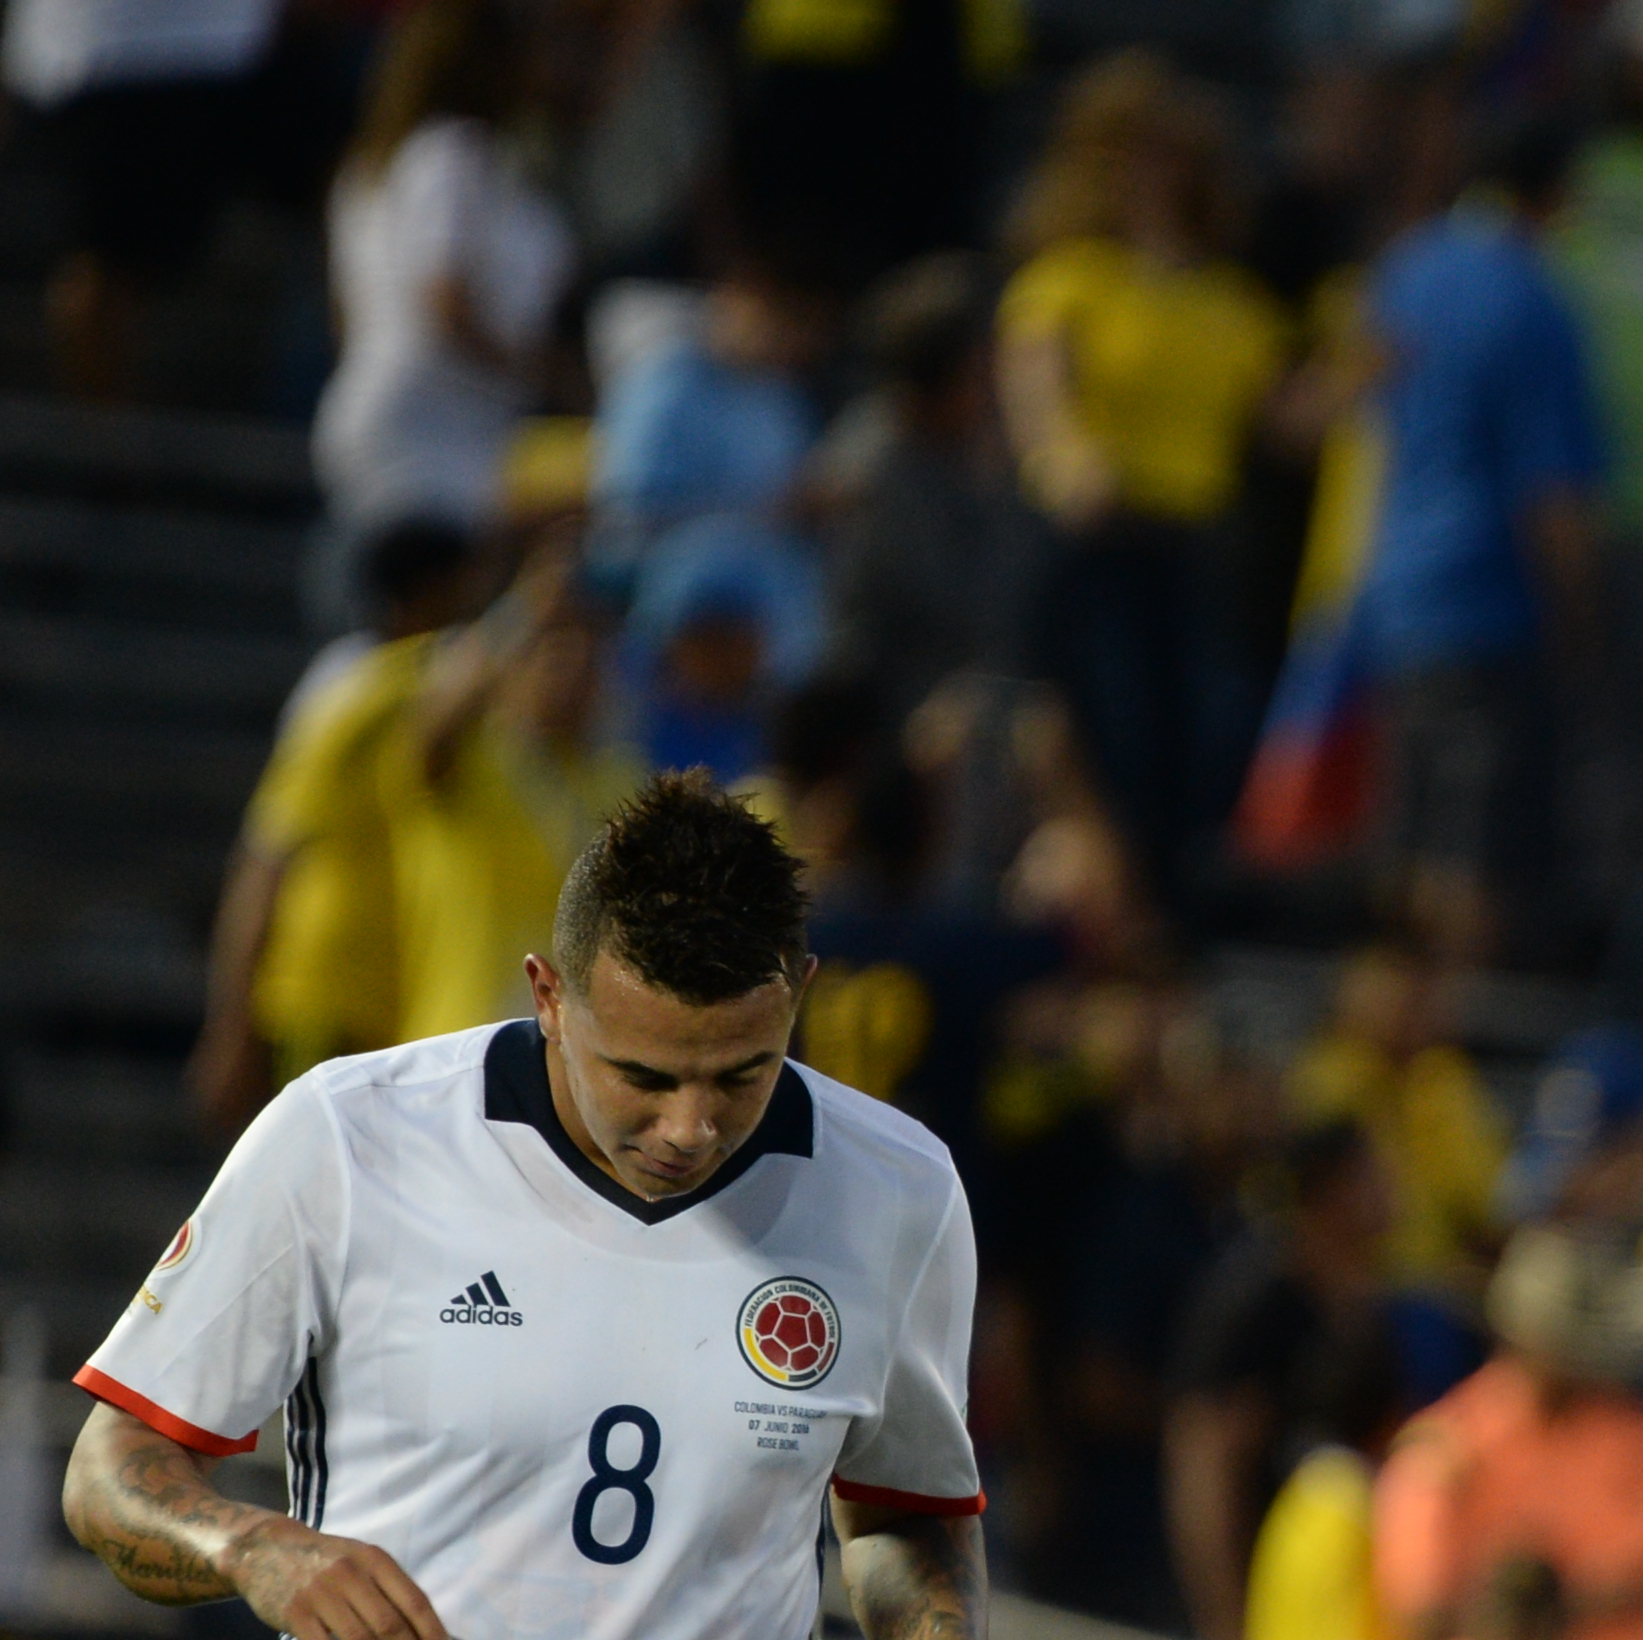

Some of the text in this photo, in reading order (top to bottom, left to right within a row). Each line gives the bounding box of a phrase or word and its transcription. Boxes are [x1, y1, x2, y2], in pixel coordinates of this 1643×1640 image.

[439, 1304, 524, 1327] adidas
[734, 1401, 776, 1415] COLOMBIA
[777, 1404, 788, 1417] VS
[748, 1419, 760, 1431] 07
[572, 1404, 661, 1565] 8
